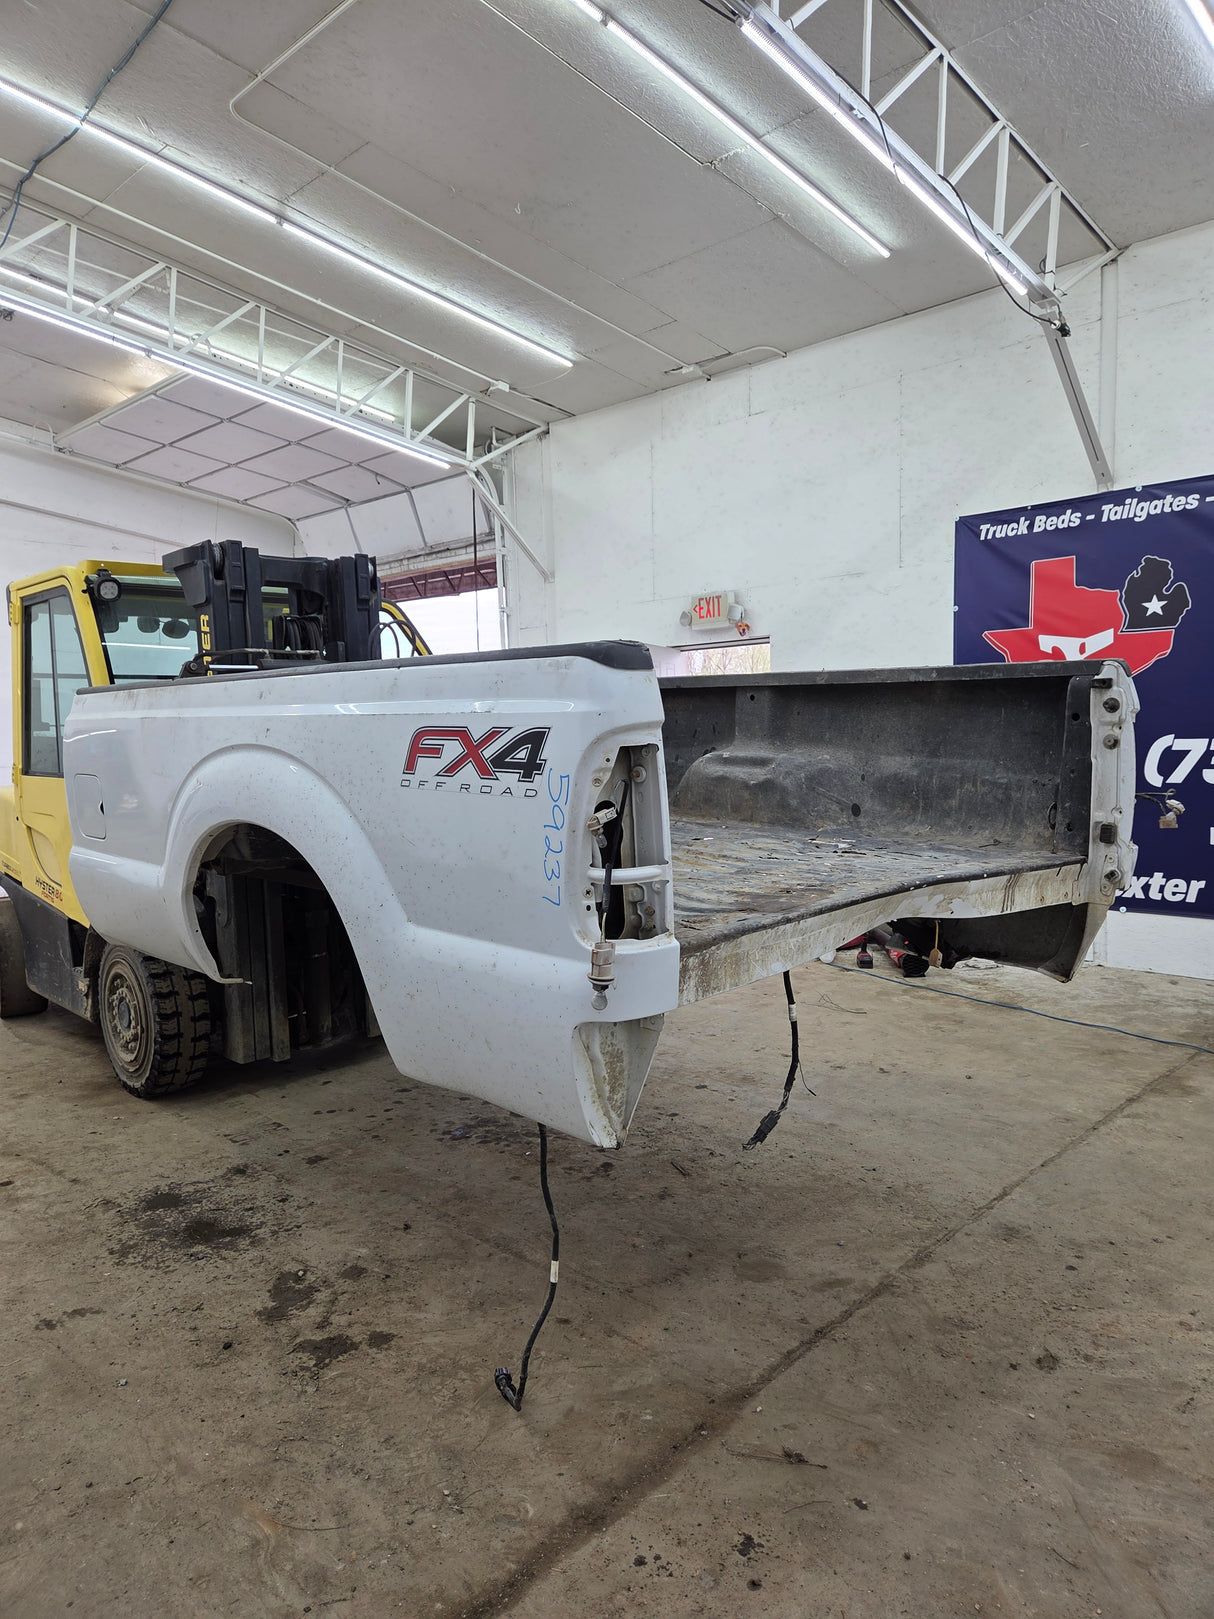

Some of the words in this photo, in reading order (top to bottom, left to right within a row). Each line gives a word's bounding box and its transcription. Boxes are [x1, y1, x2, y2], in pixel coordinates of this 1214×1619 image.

[979, 517, 1029, 540] Truck
[1033, 509, 1081, 532] Beds
[1101, 493, 1200, 522] Tailgates
[698, 595, 722, 619] EXIT
[200, 614, 213, 676] TER
[402, 726, 552, 783] FX4
[1143, 733, 1214, 788] (7
[400, 778, 447, 791] OFF
[459, 783, 539, 798] ROAD
[542, 767, 570, 907] 59237
[1115, 871, 1207, 903] xter
